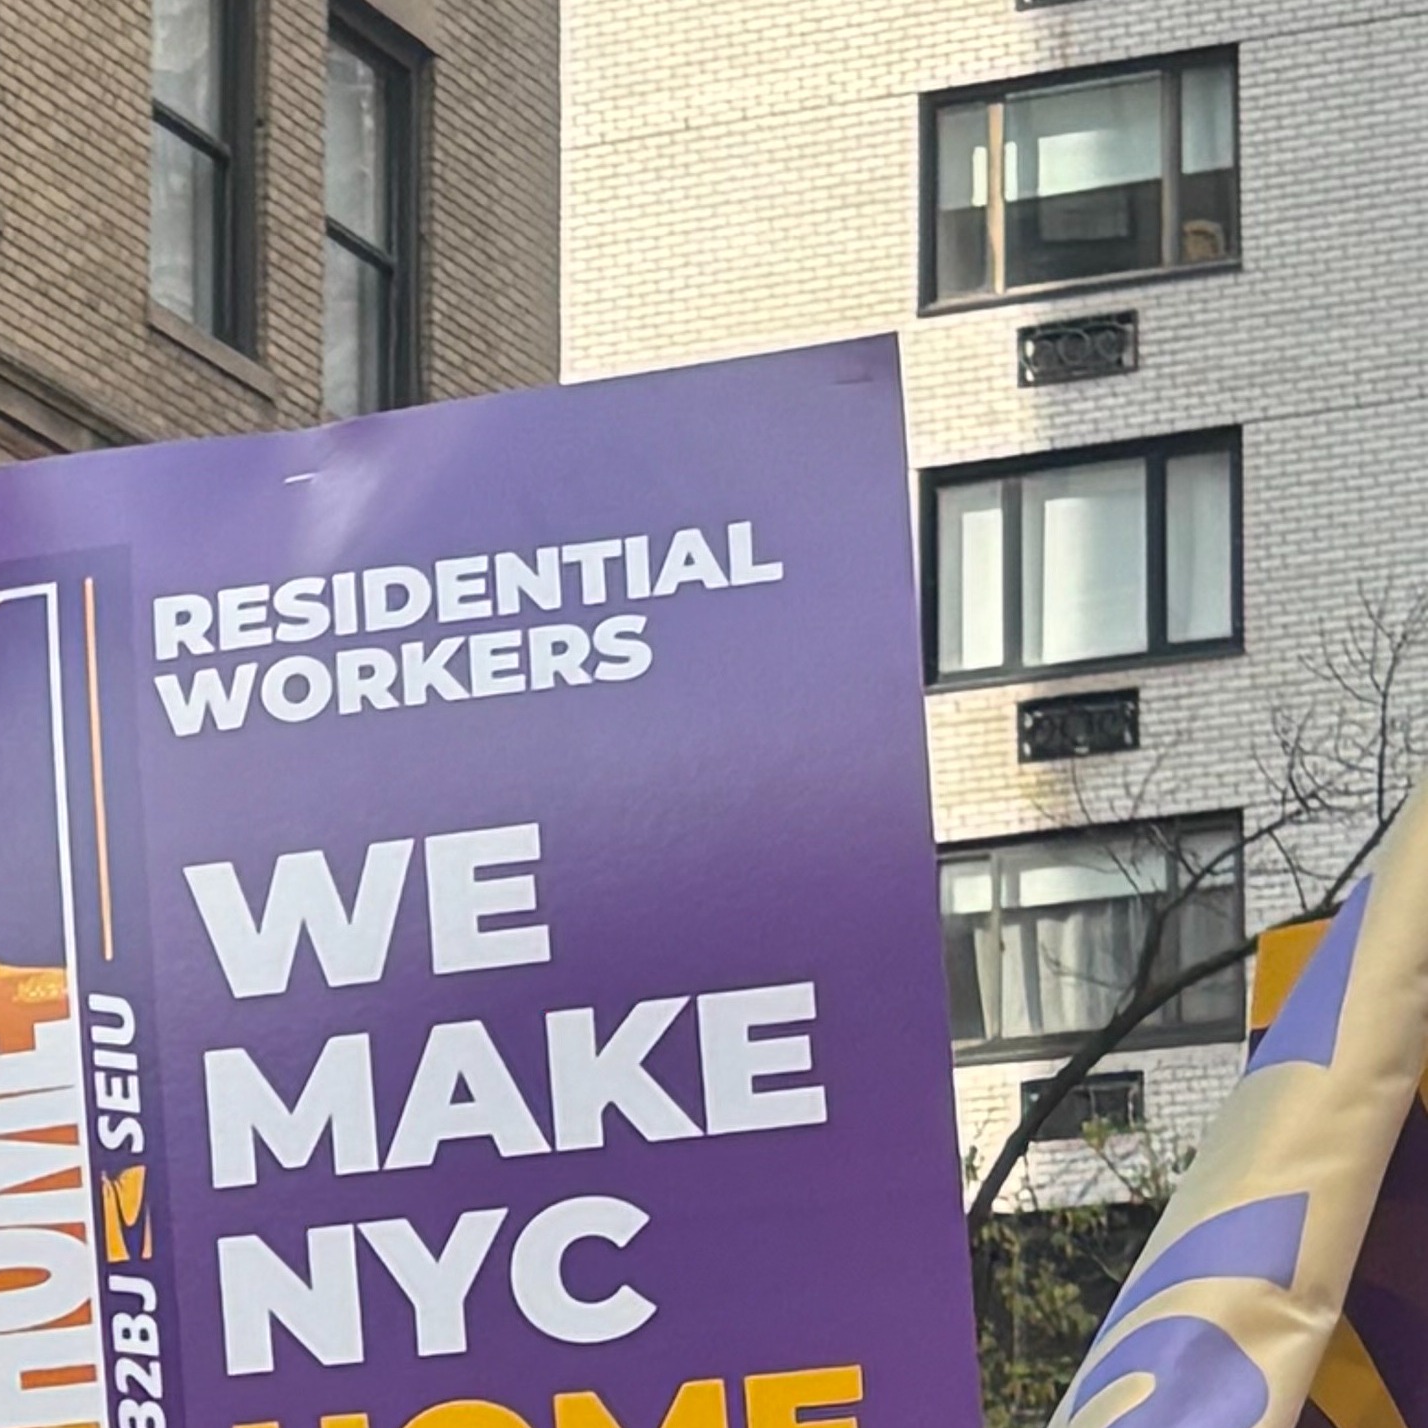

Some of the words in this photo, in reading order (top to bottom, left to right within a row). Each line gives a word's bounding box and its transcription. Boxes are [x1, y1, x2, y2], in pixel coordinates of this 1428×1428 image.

[154, 521, 783, 661] RESIDENTIAL
[154, 616, 653, 737] WORKERS
[183, 822, 552, 999] WE
[88, 992, 144, 1154] SEIU
[204, 981, 829, 1189] MAKE
[218, 1196, 658, 1376] NYC
